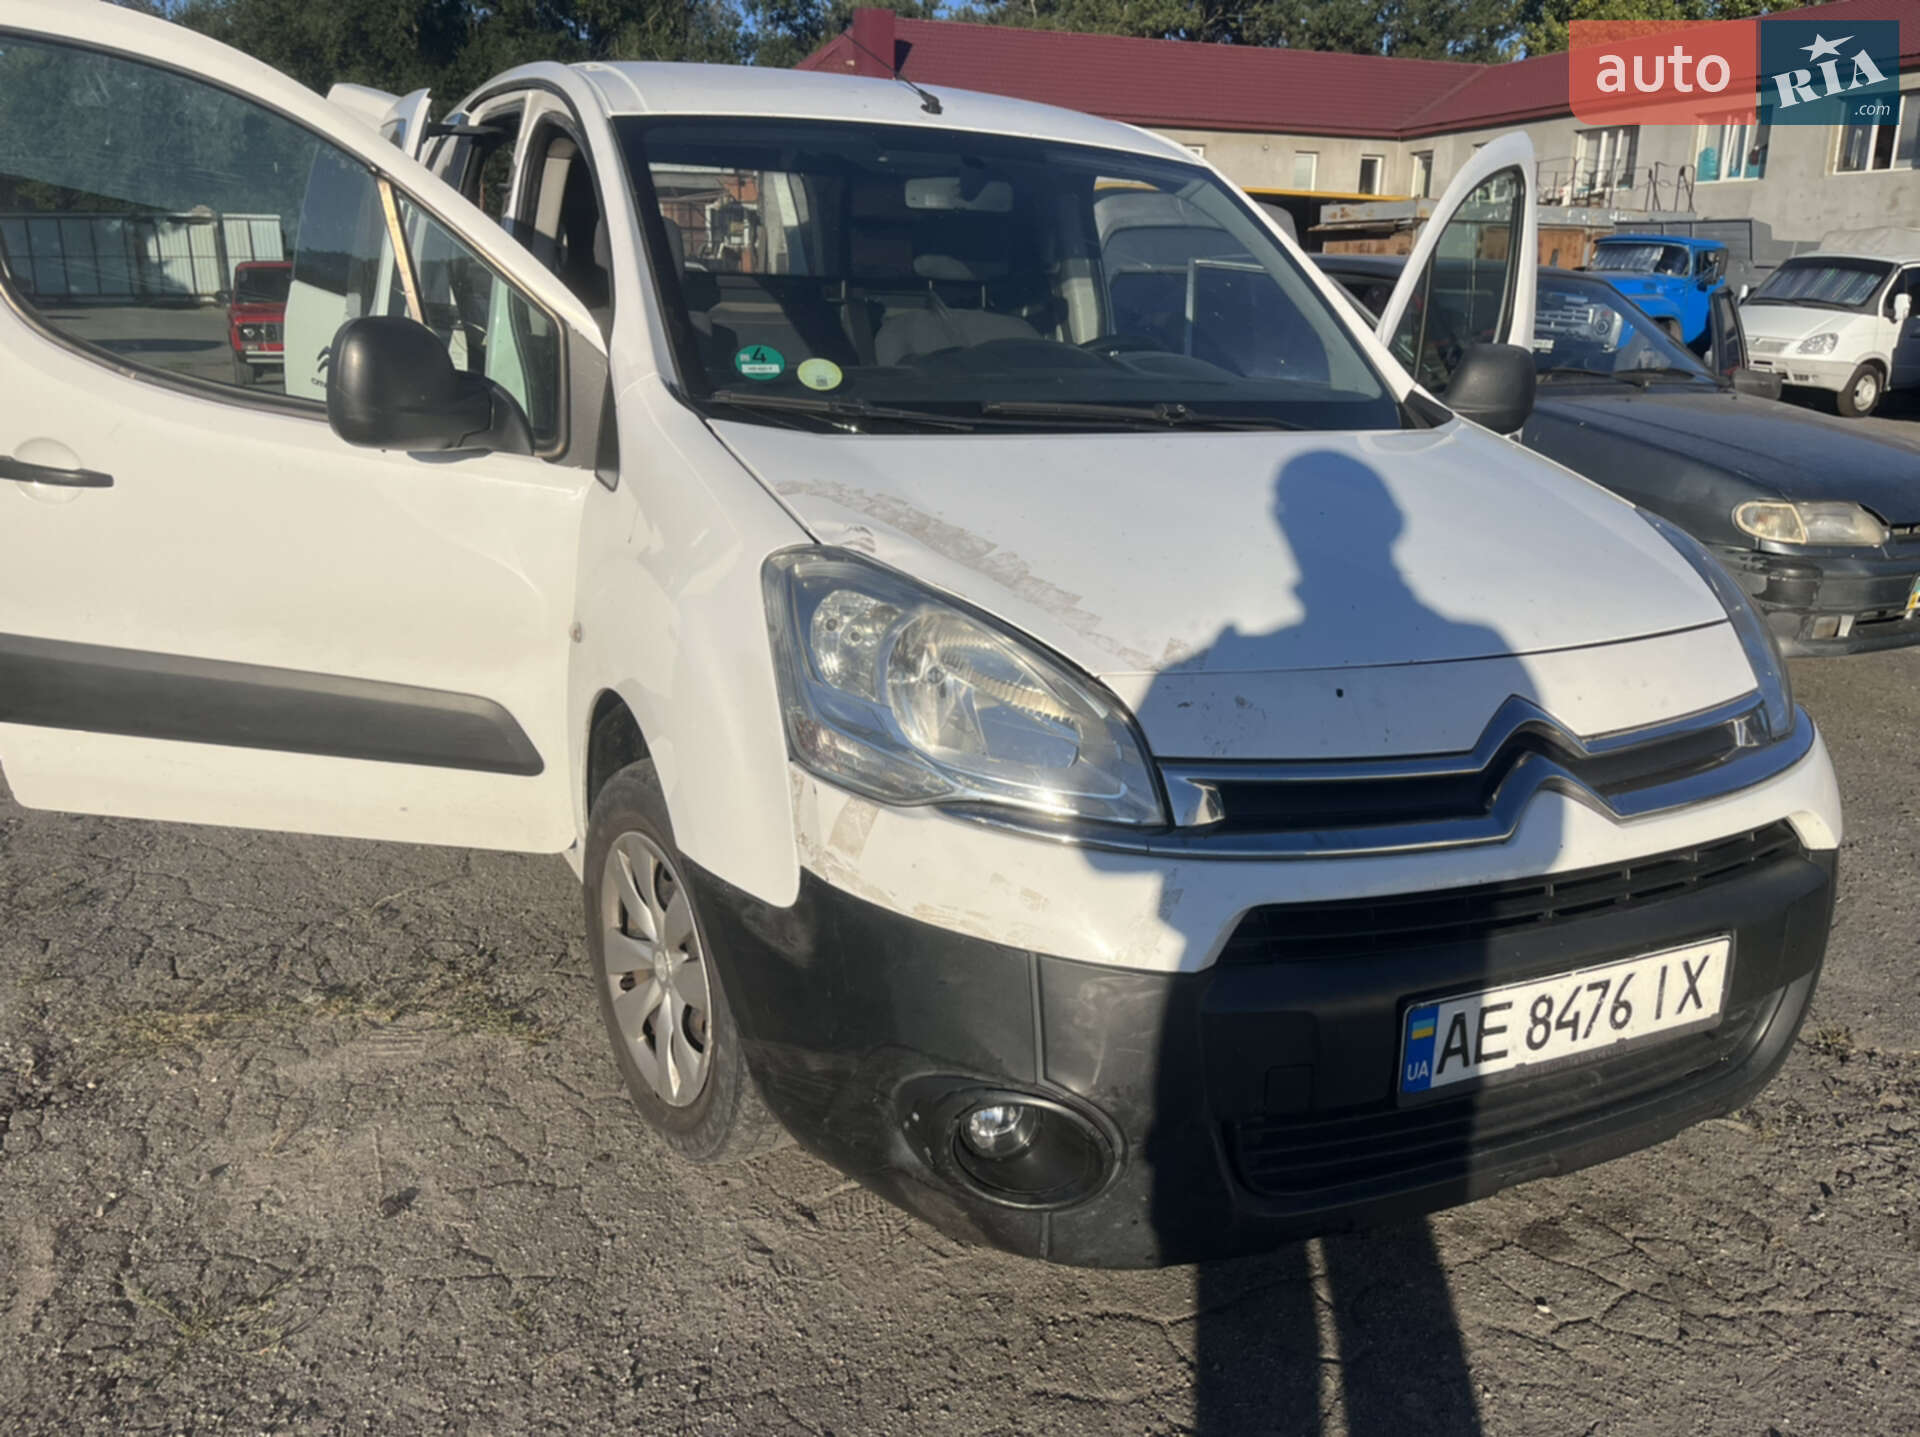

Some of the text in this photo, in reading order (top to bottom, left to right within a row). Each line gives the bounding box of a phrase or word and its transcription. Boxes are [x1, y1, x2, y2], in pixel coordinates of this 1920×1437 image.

[752, 346, 767, 363] 4
[1436, 1002, 1513, 1075] AE
[1525, 973, 1637, 1051] 8476
[1654, 955, 1710, 1021] IX
[1407, 1060, 1430, 1081] UA
